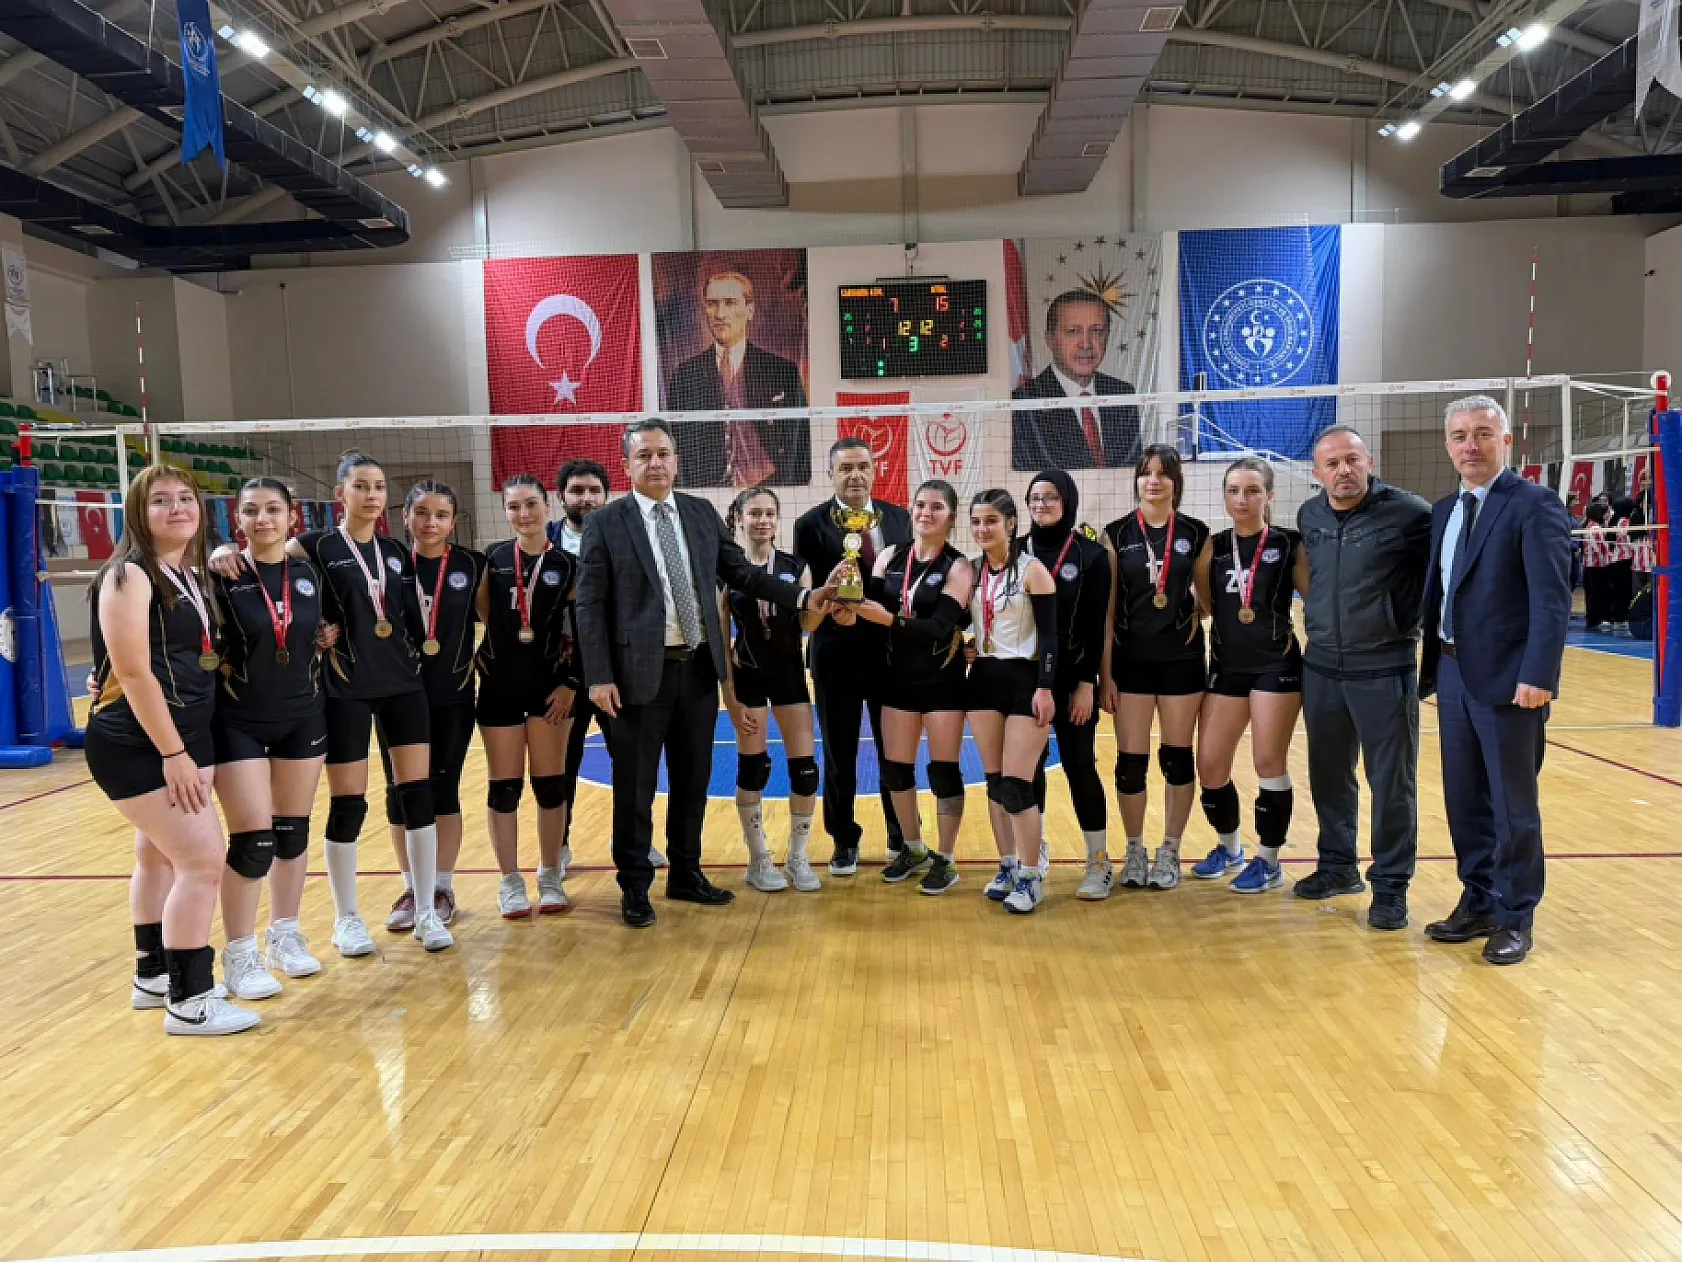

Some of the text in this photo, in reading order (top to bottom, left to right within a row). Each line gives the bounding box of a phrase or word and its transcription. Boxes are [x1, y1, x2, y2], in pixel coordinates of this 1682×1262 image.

[890, 297, 899, 313] 7
[936, 296, 949, 312] 15
[909, 336, 919, 352] 3
[929, 459, 963, 476] TVF
